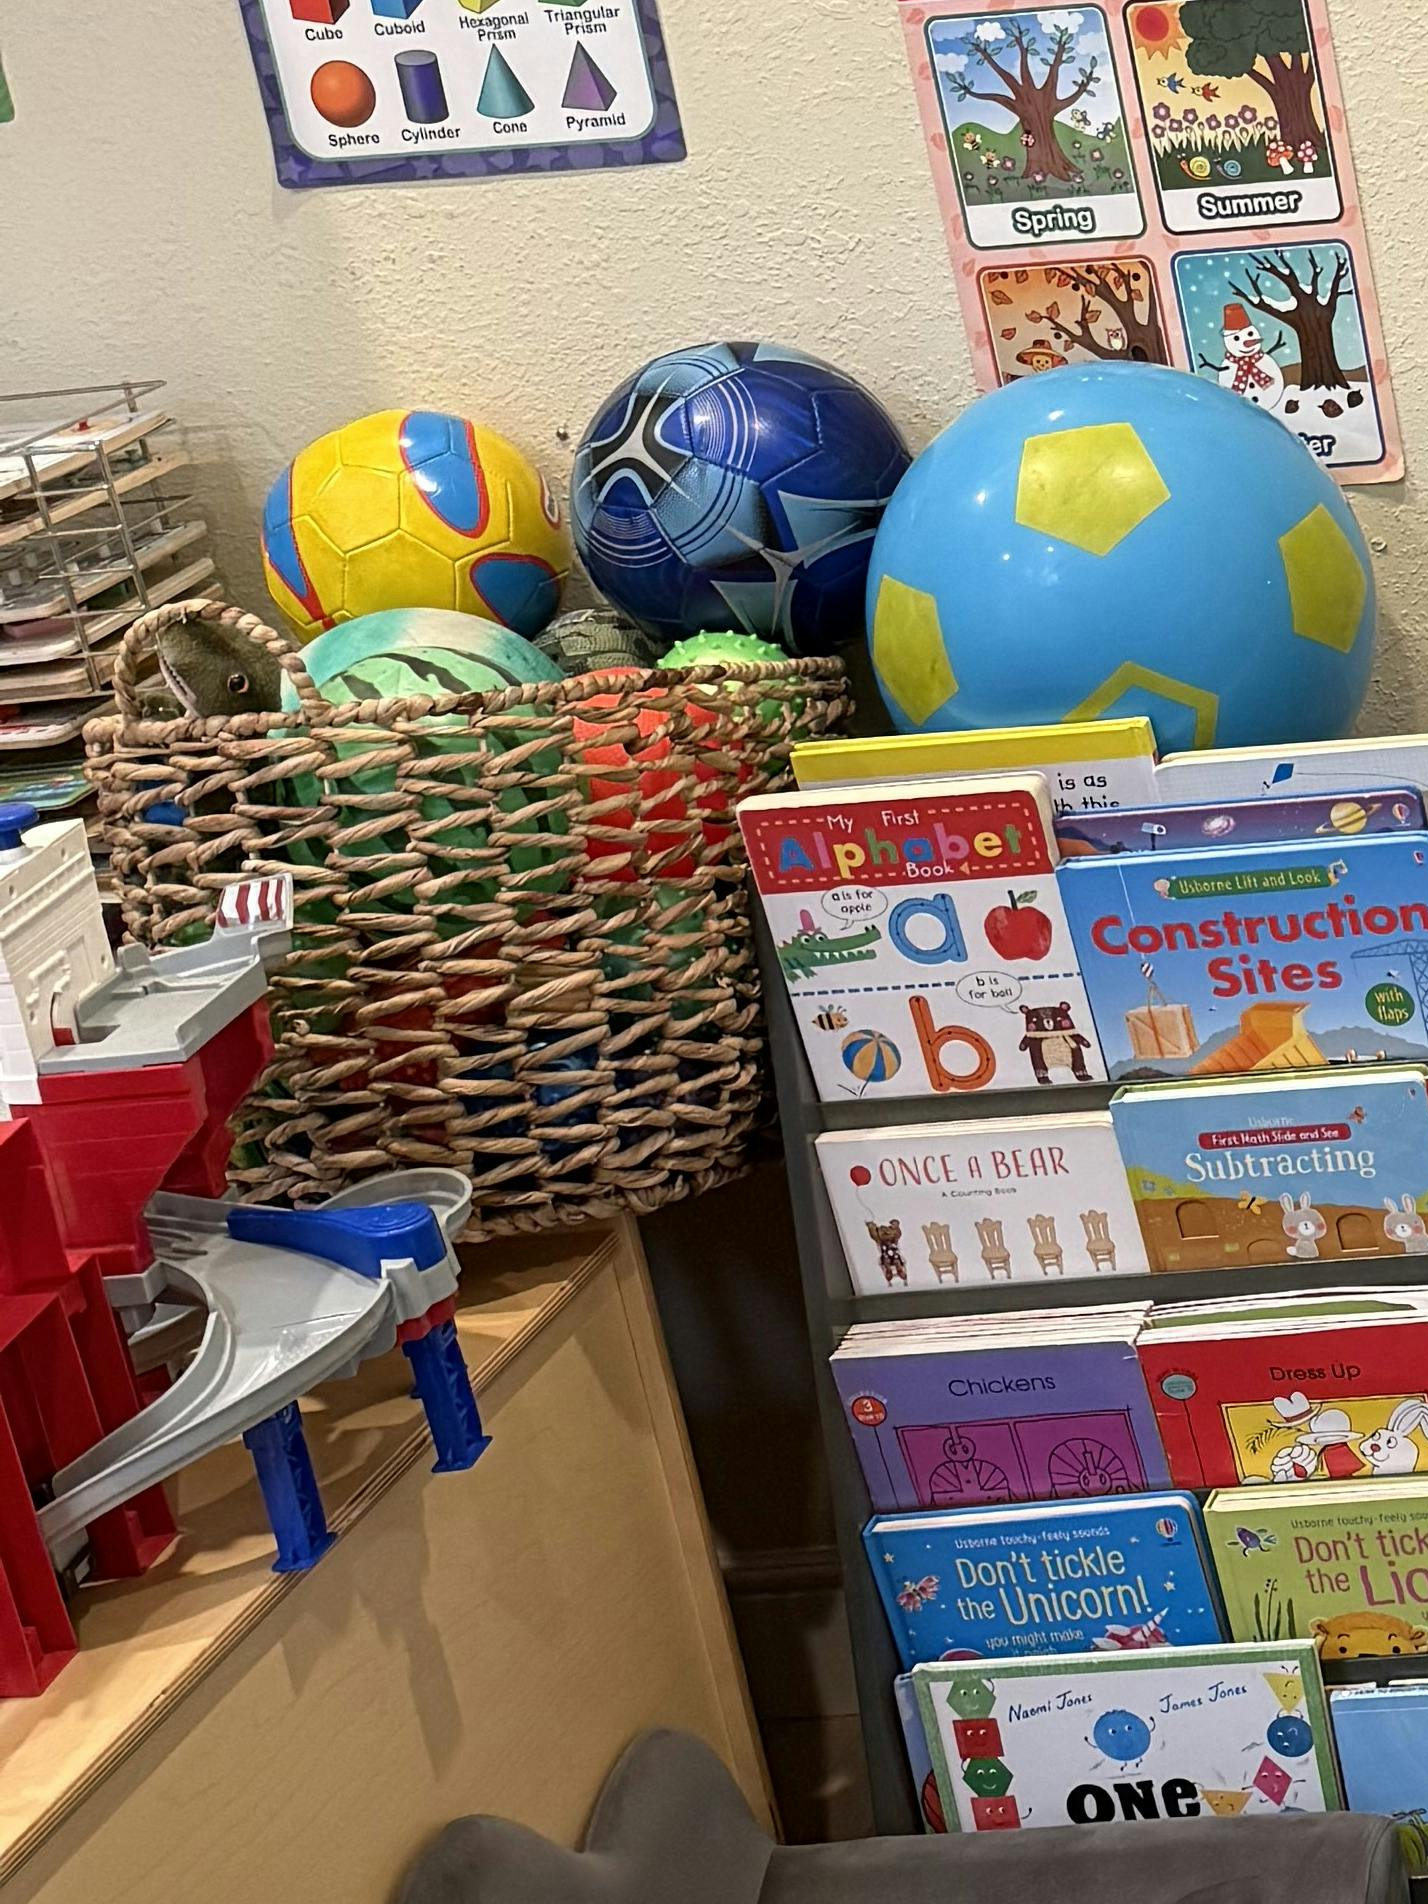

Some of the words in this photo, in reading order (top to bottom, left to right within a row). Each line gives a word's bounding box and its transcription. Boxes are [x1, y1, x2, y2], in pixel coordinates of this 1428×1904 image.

[459, 12, 529, 32] Hexagonal
[544, 6, 620, 26] Triangular
[305, 28, 344, 42] Cube
[374, 21, 425, 37] Cuboid
[493, 122, 527, 134] Cone
[566, 113, 625, 130] Pyramid
[328, 132, 380, 149] Sphere
[401, 126, 460, 144] Cylinder
[1198, 189, 1301, 220] Summer
[1011, 205, 1095, 235] Spring
[827, 815, 854, 833] My
[881, 809, 919, 827] First
[779, 823, 1022, 878] Alphabet
[905, 862, 954, 878] Book
[1208, 953, 1343, 998] Sites
[879, 1158, 960, 1187] ONCE
[968, 1157, 982, 1183] A
[997, 1147, 1070, 1179] BEAR
[1185, 1147, 1377, 1185] Subtracting
[948, 1374, 1056, 1396] Chickens
[955, 1551, 1036, 1589] Don't
[1040, 1546, 1125, 1582] tickle
[958, 1598, 996, 1621] the
[999, 1575, 1154, 1625] Unicorn!
